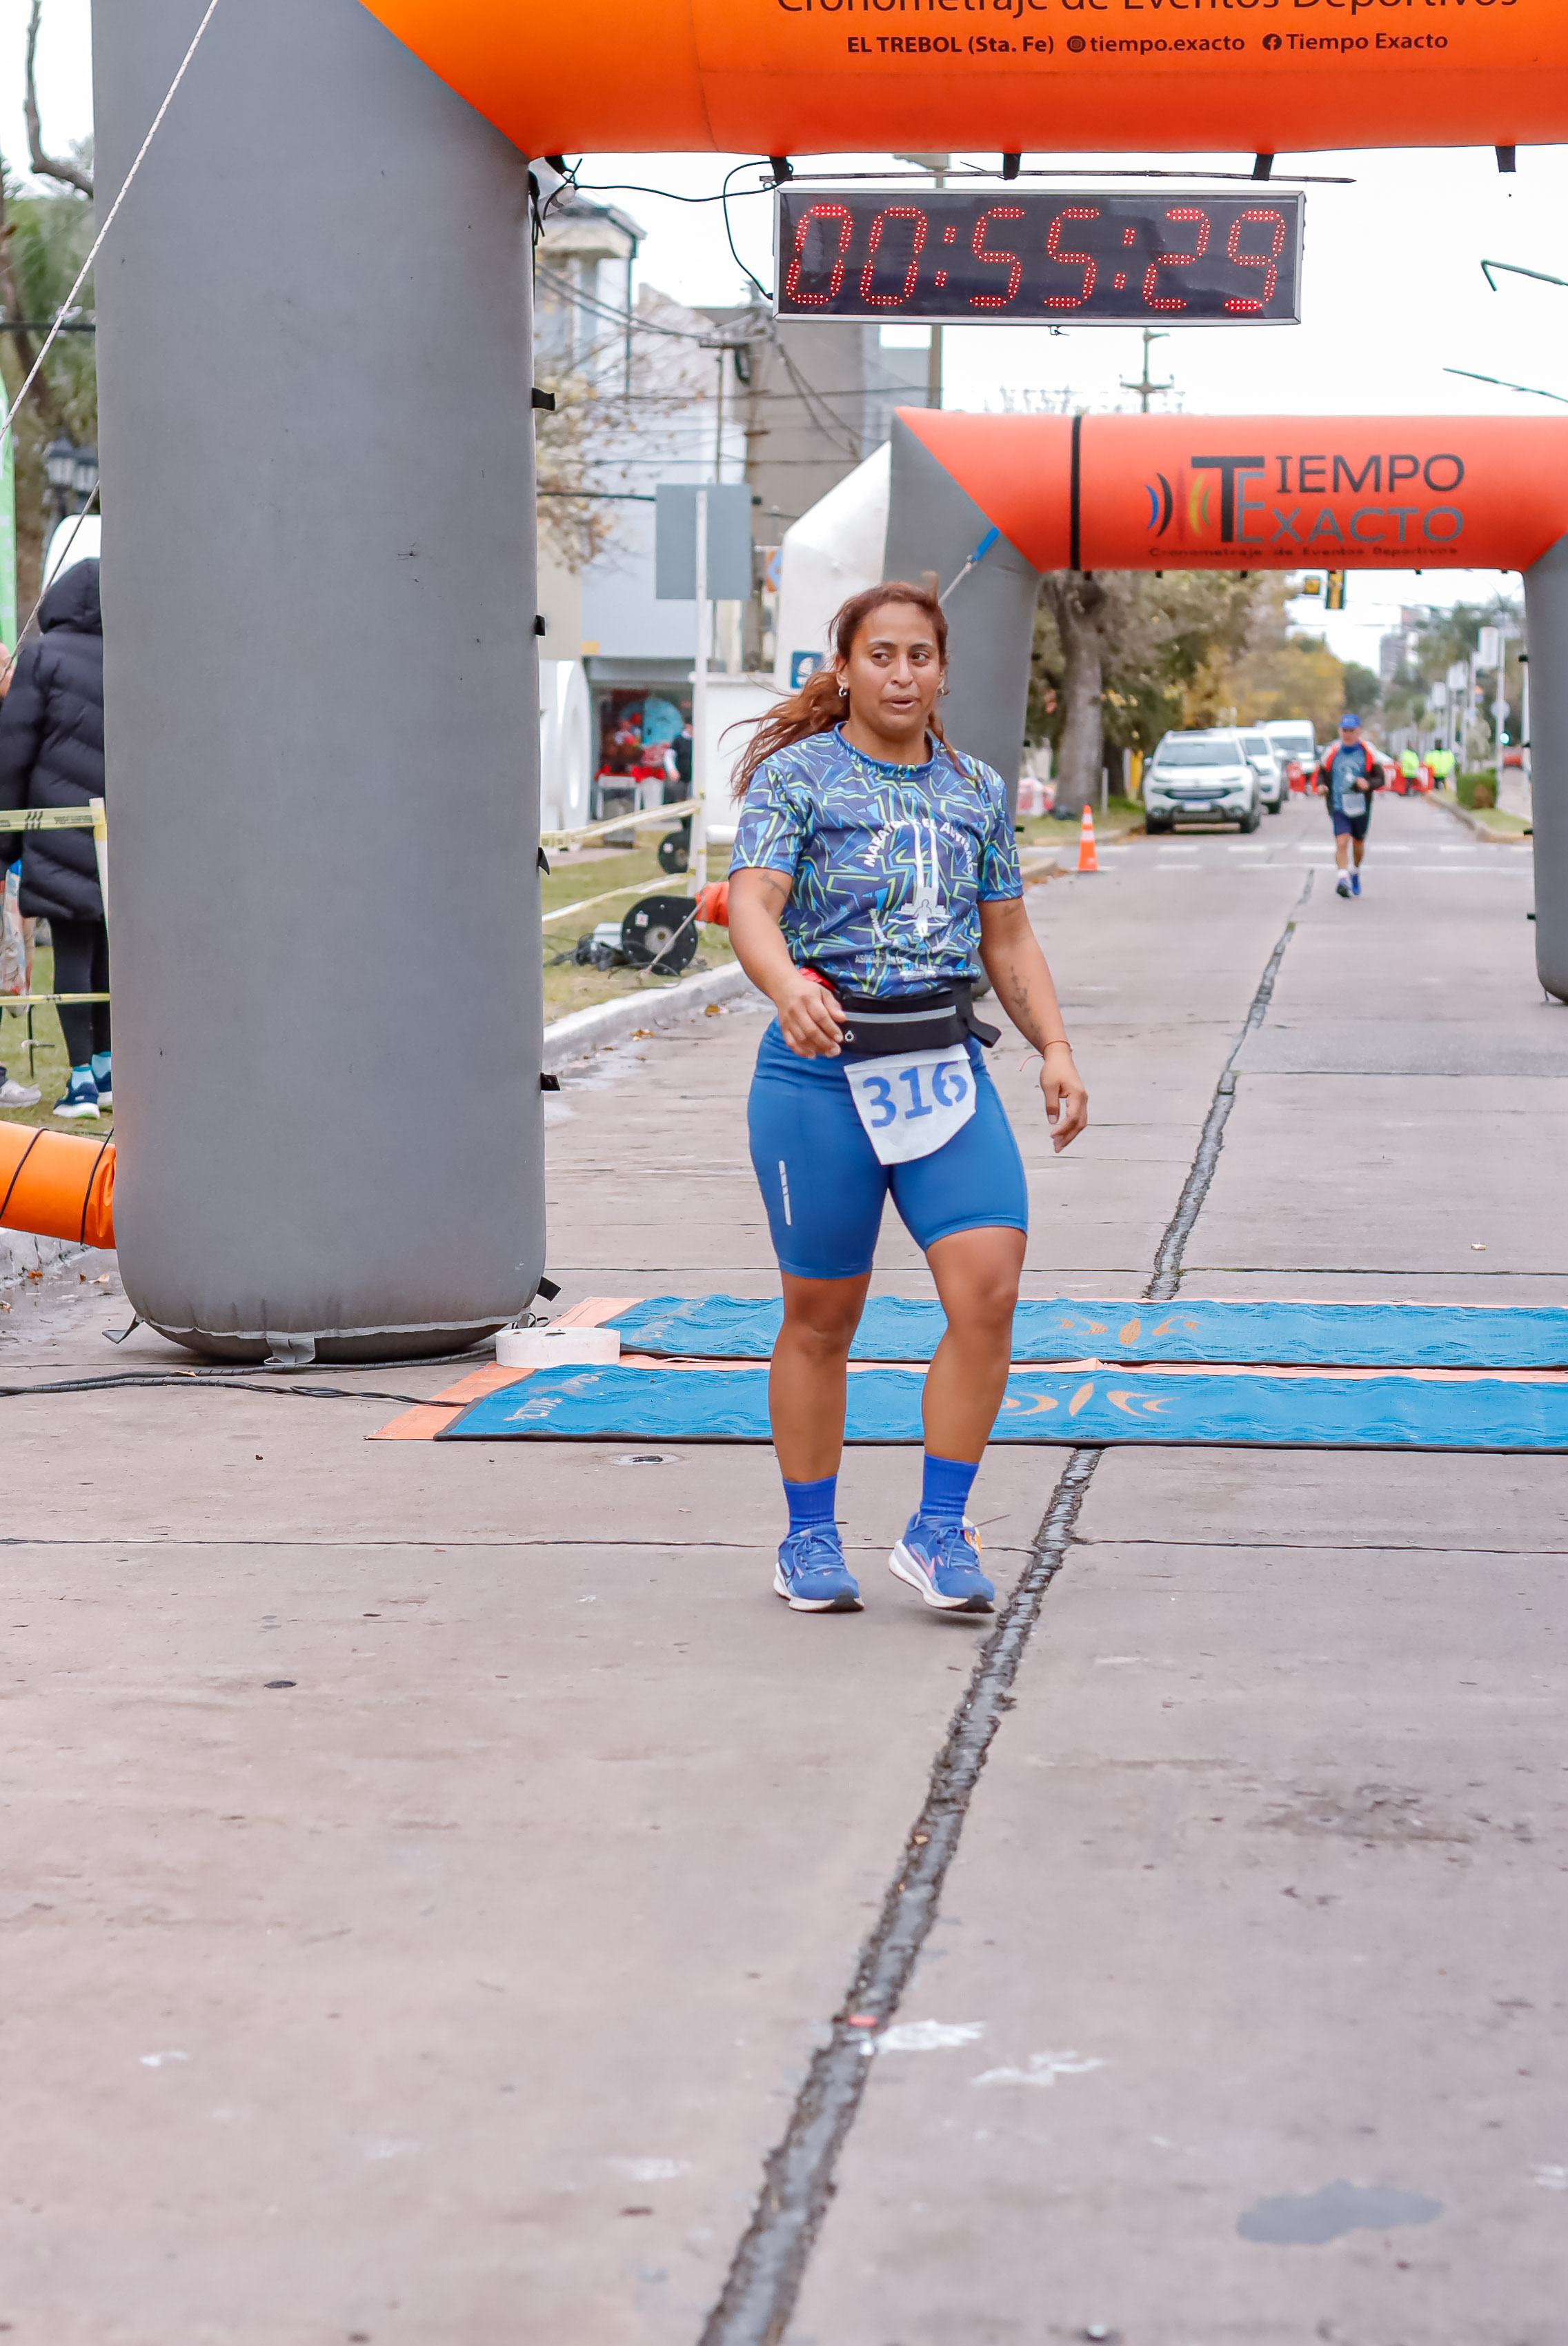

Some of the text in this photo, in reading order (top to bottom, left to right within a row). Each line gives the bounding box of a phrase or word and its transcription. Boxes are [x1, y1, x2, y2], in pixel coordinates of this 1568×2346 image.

[848, 32, 1448, 55] EL TREBOL (Sta. Fe) tiempo.exacto Tiempo Exacto
[785, 203, 1287, 310] 00:55:29
[1191, 453, 1465, 542] TIEMPO
[1236, 470, 1465, 543] EXACTO
[863, 1060, 968, 1128] 316
